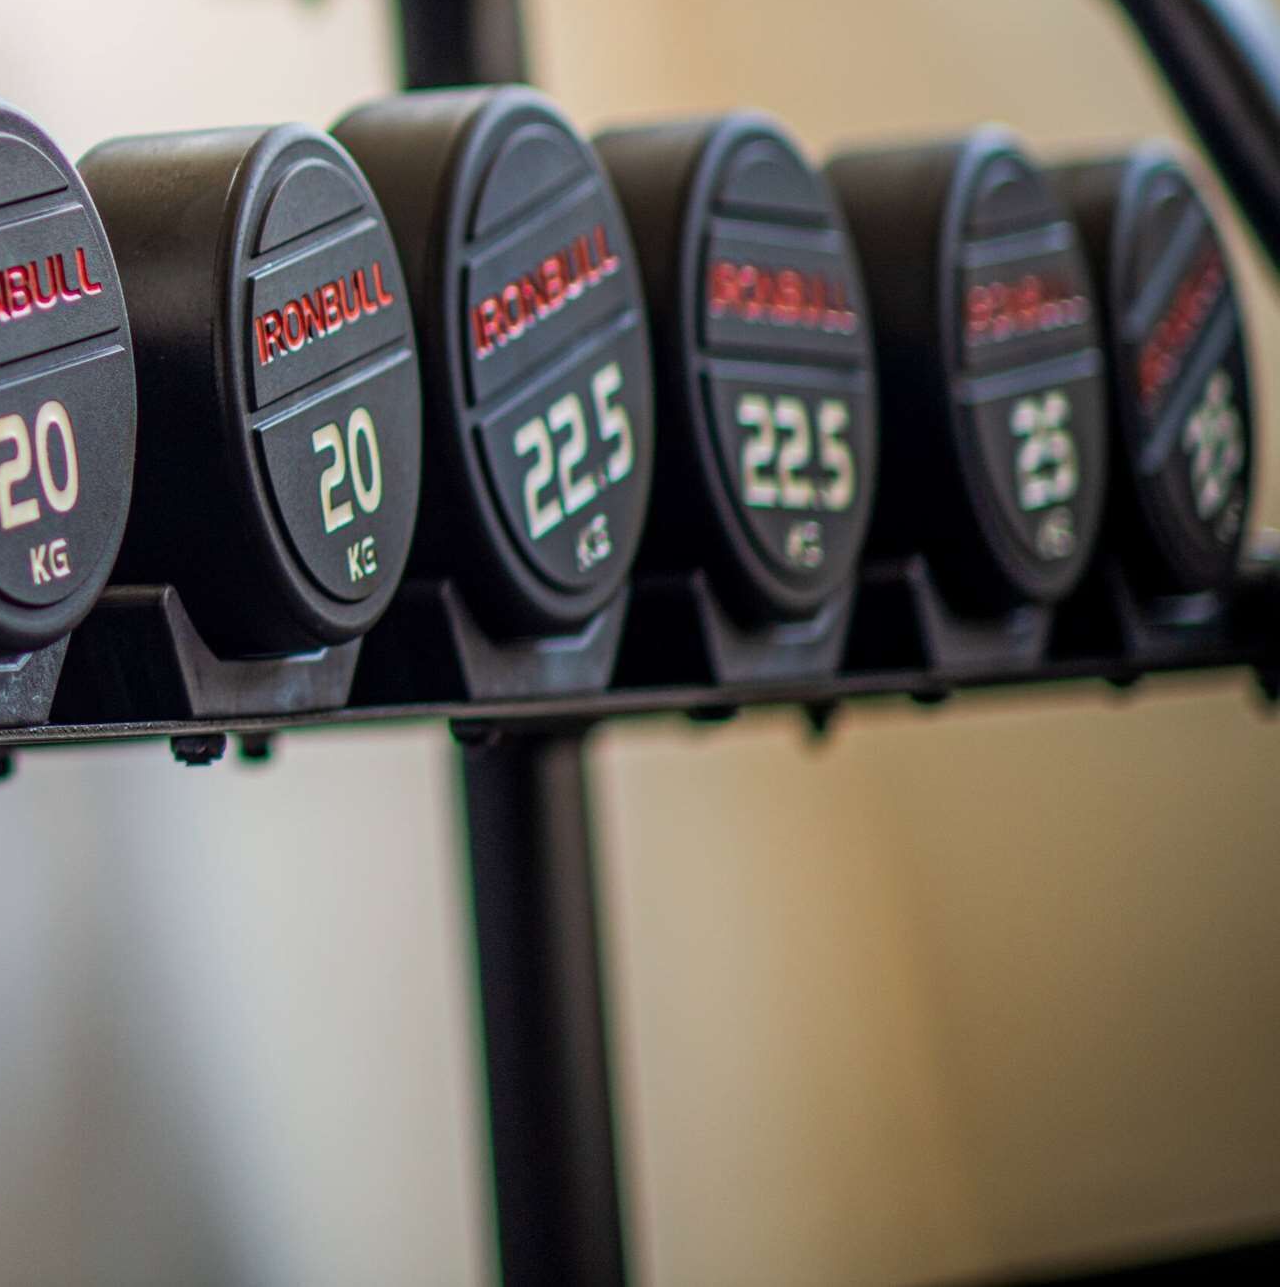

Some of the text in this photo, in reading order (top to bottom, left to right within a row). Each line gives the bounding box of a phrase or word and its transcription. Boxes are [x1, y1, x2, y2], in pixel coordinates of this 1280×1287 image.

[254, 261, 394, 366] IRONBULL
[311, 406, 383, 533] 20
[29, 538, 71, 584] KG
[347, 536, 378, 581] KG
